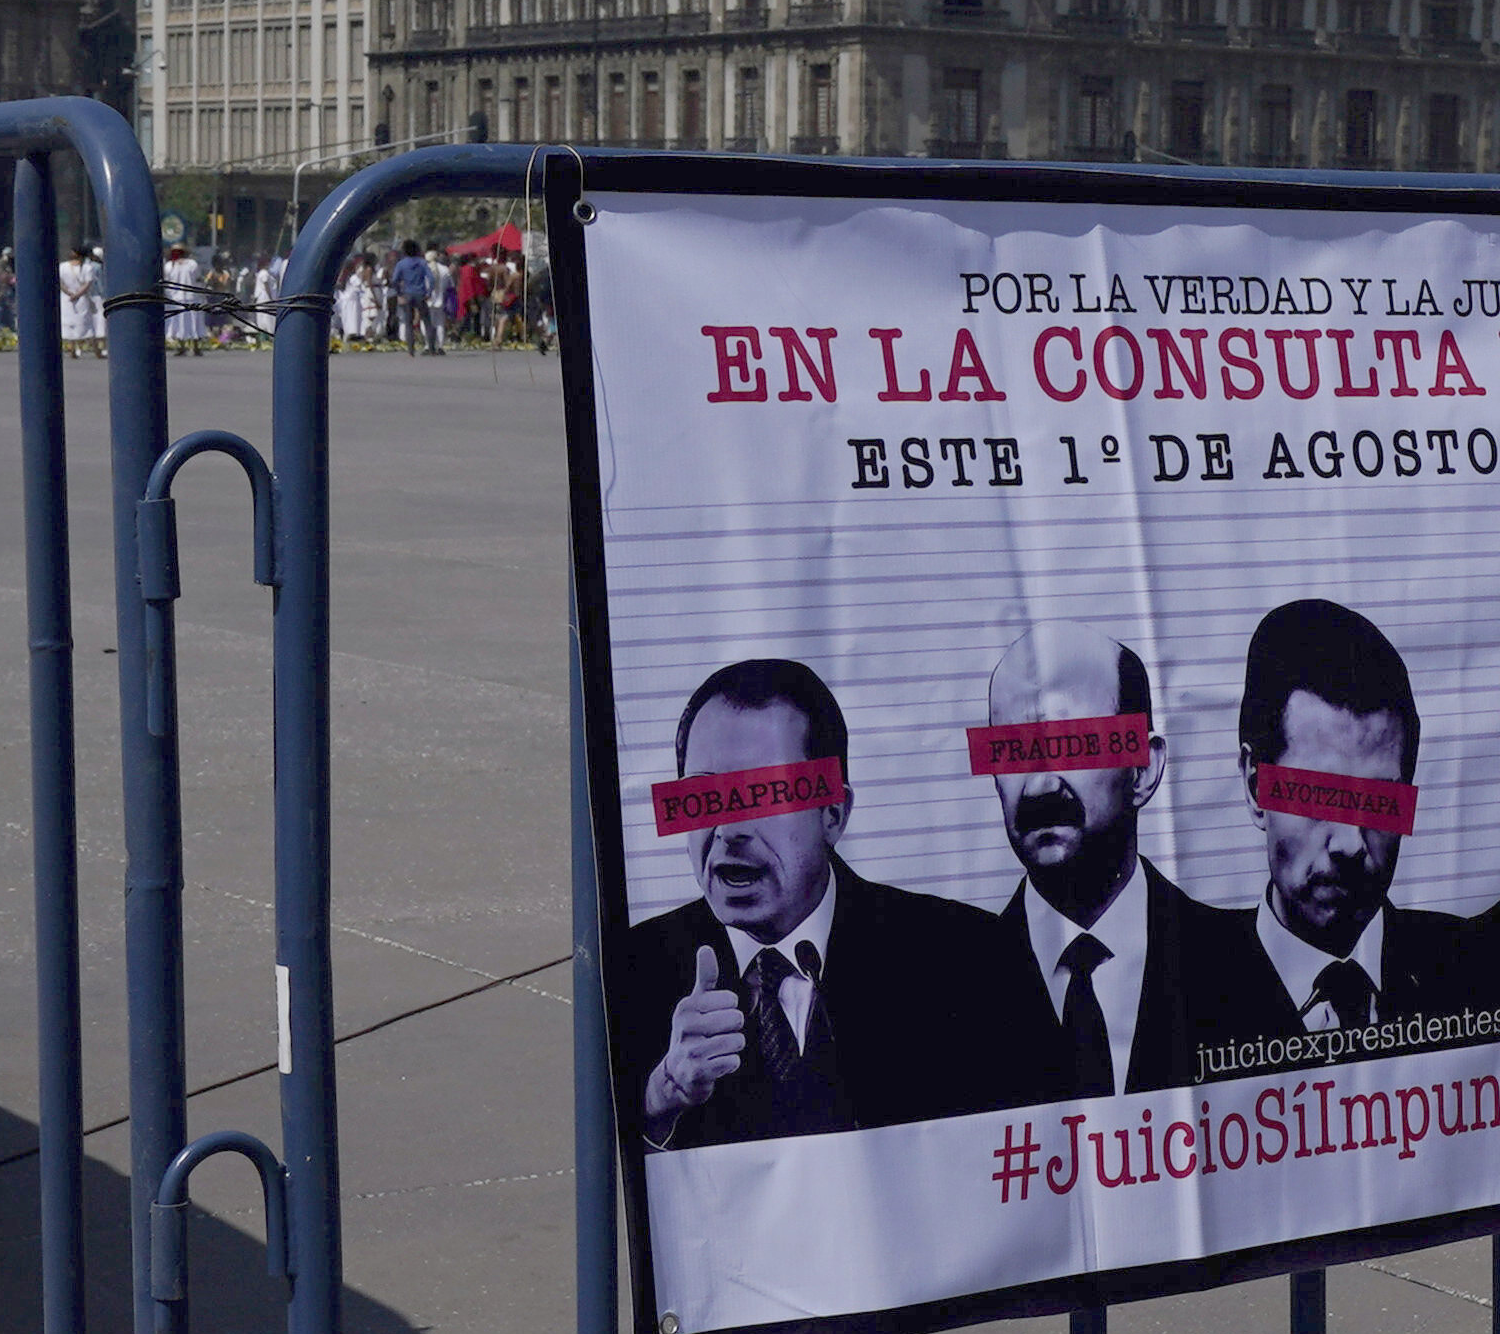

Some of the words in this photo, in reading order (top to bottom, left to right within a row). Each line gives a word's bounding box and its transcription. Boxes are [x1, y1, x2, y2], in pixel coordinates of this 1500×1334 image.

[960, 272, 1060, 314] POR
[1069, 273, 1137, 314] LA
[1143, 275, 1332, 316] VERDAD
[1340, 278, 1372, 317] Y
[1384, 278, 1444, 317] LA
[701, 325, 838, 404] EN
[868, 327, 1007, 403] LA
[1032, 324, 1487, 402] CONSULTA
[848, 436, 1024, 490] ESTE
[1148, 432, 1235, 483] DE
[1262, 427, 1499, 480] AGOSTO
[988, 731, 1101, 765] FRAUDE
[1107, 729, 1141, 756] 88
[660, 771, 834, 823] FOBAPROA
[1269, 780, 1402, 817] AYOTZINAPA
